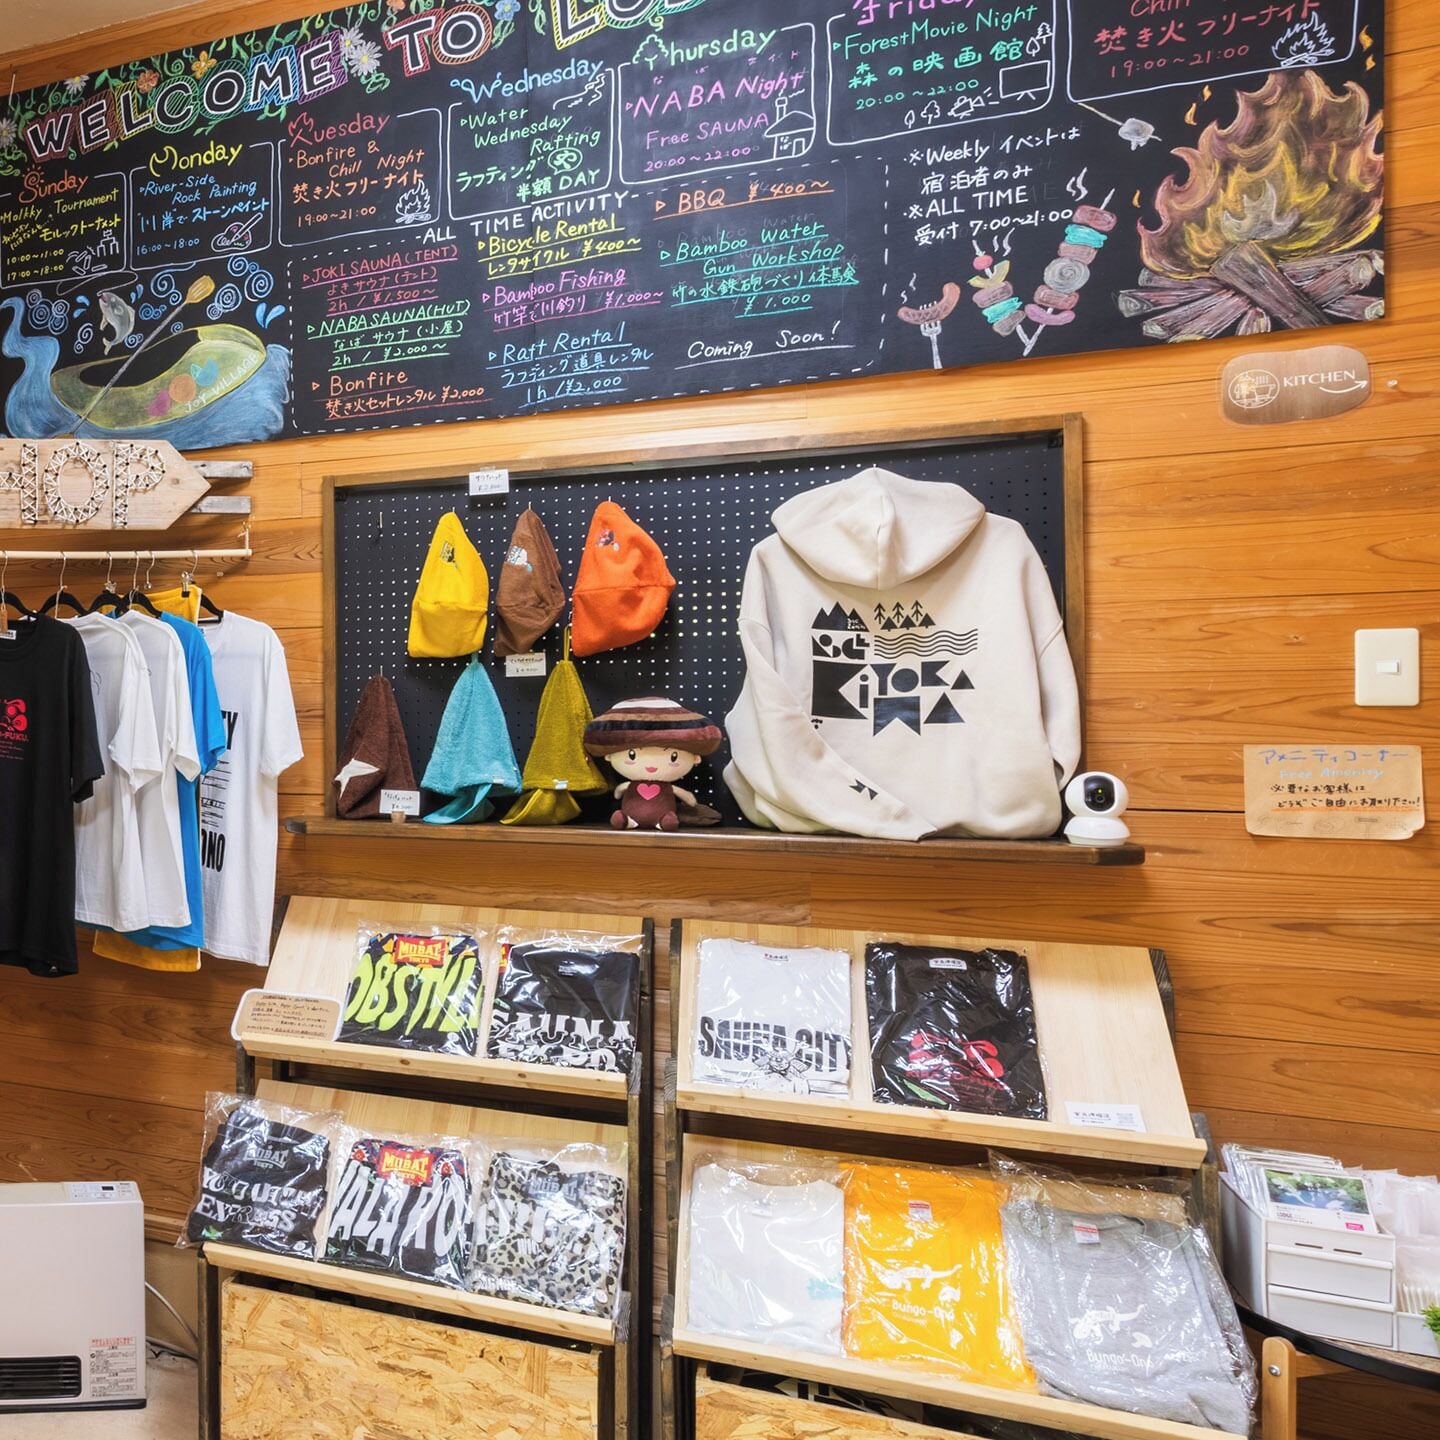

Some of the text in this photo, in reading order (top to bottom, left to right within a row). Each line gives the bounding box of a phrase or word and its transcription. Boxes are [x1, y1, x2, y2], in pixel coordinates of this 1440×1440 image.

[844, 4, 1038, 59] Forest Movie Night
[848, 37, 1024, 89] 森の映画館
[25, 33, 345, 161] WELCOME
[385, 6, 492, 77] TO
[450, 58, 603, 103] Wednesday
[634, 71, 804, 118] NABA Night
[468, 108, 528, 129] Water
[474, 115, 572, 148] Wednesday
[646, 112, 769, 149] Free SAUNA
[297, 140, 380, 168] Bonfire &
[530, 130, 601, 156] Rafting
[999, 127, 1081, 154] イベントは
[149, 140, 243, 177] Monday
[329, 149, 425, 178] Chill Night
[19, 168, 88, 203] Sunday
[144, 174, 216, 196] River-Side
[172, 181, 257, 204] Rock Painting
[292, 169, 424, 204] 焚き火フリーナイト
[516, 169, 600, 202] 半額 DAY
[921, 165, 1033, 195] 宿泊者のみ
[54, 188, 119, 214] Tournament
[678, 188, 726, 213] BBQ
[972, 185, 1029, 209] TIME
[470, 214, 525, 236] TIME
[532, 191, 628, 222] ACTIVITY
[488, 213, 616, 257] Bicycle Rental
[676, 222, 824, 262] Bamboo Water
[914, 222, 959, 246] 受付
[703, 241, 845, 275] Gun Workshop
[311, 263, 346, 283] JOKI
[494, 268, 626, 307] Bamboo Fishing
[327, 299, 348, 311] 2h
[319, 313, 367, 337] NABA
[503, 321, 625, 364] Raft Rental
[687, 340, 753, 359] Coming
[332, 354, 352, 366] 2h
[330, 370, 409, 397] Bonfire
[1283, 369, 1356, 387] KITCHEN
[184, 393, 207, 413] JOY
[527, 386, 547, 403] 1h
[491, 1008, 637, 1051] SAUNA
[698, 1016, 788, 1062] SAUNA
